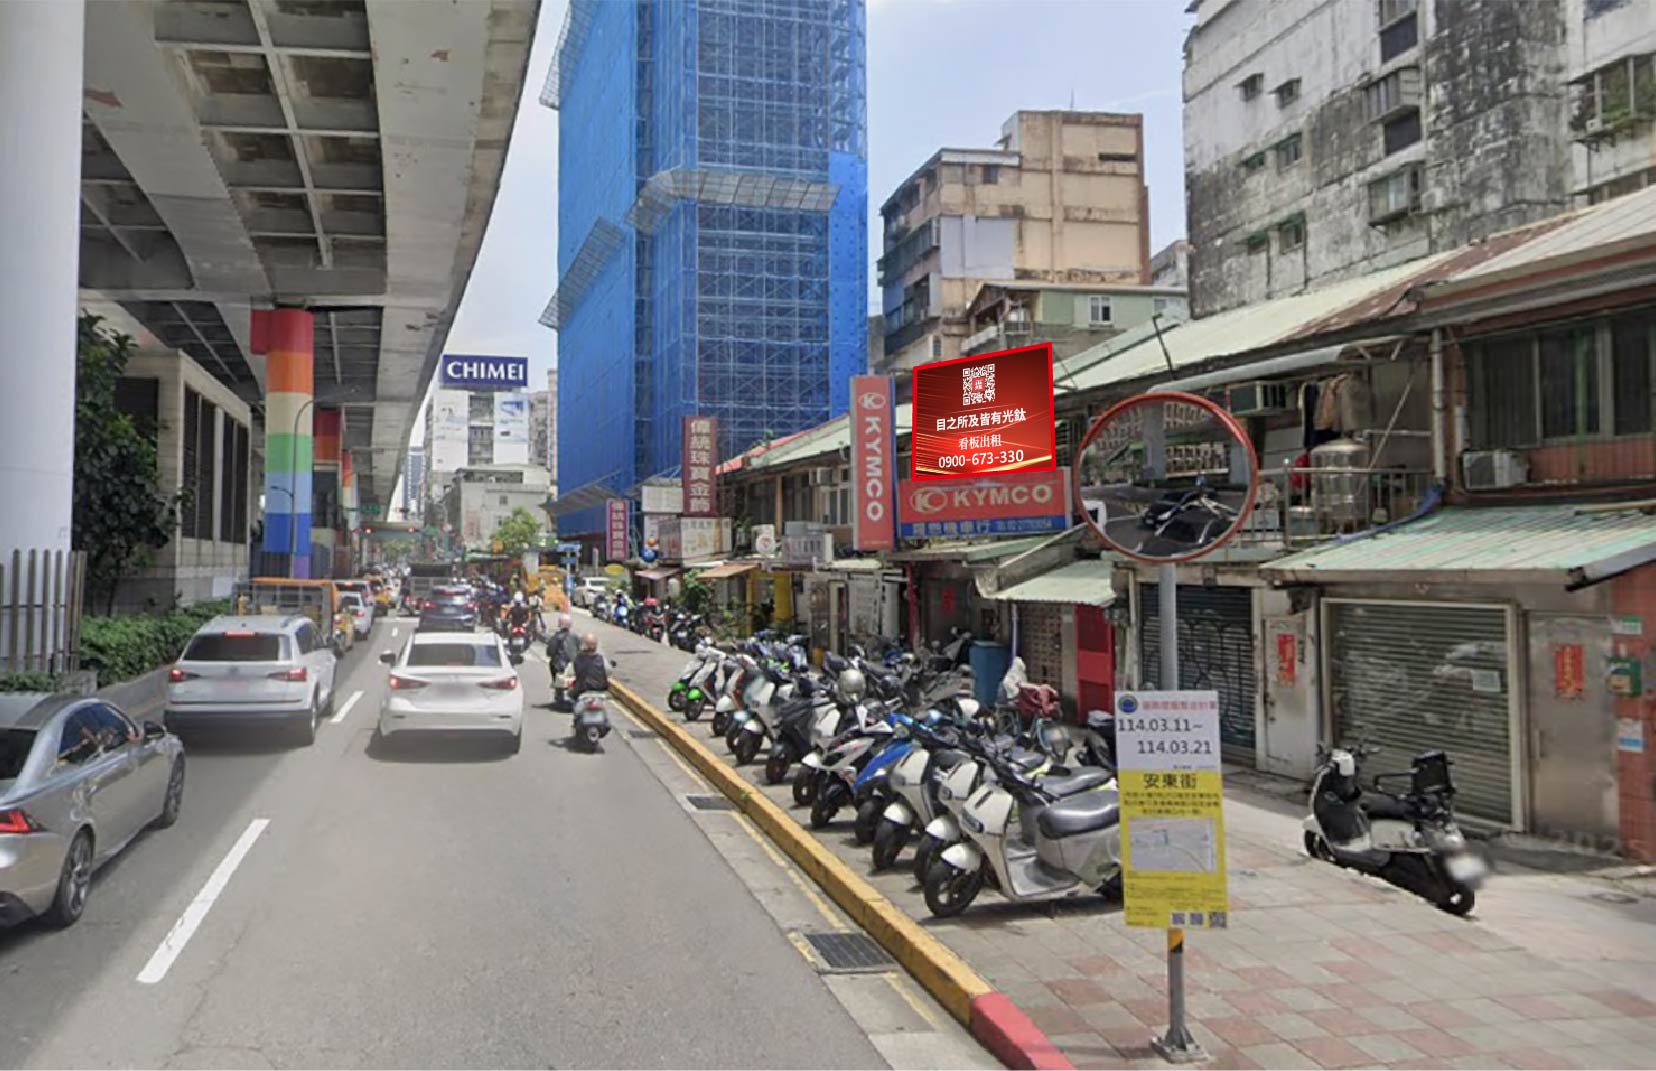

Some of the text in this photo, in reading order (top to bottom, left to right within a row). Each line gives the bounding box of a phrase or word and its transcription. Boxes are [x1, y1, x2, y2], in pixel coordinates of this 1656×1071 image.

[446, 361, 524, 381] CHIMEI
[936, 408, 1027, 431] 目之所及皆有光鈦
[958, 434, 1002, 450] 看板出租
[938, 450, 1025, 468] 0900-673-330
[865, 416, 884, 522] KYMCO
[956, 484, 1053, 507] KYMCO
[1137, 740, 1212, 754] 114.03.21
[1143, 773, 1197, 789] 安東街
